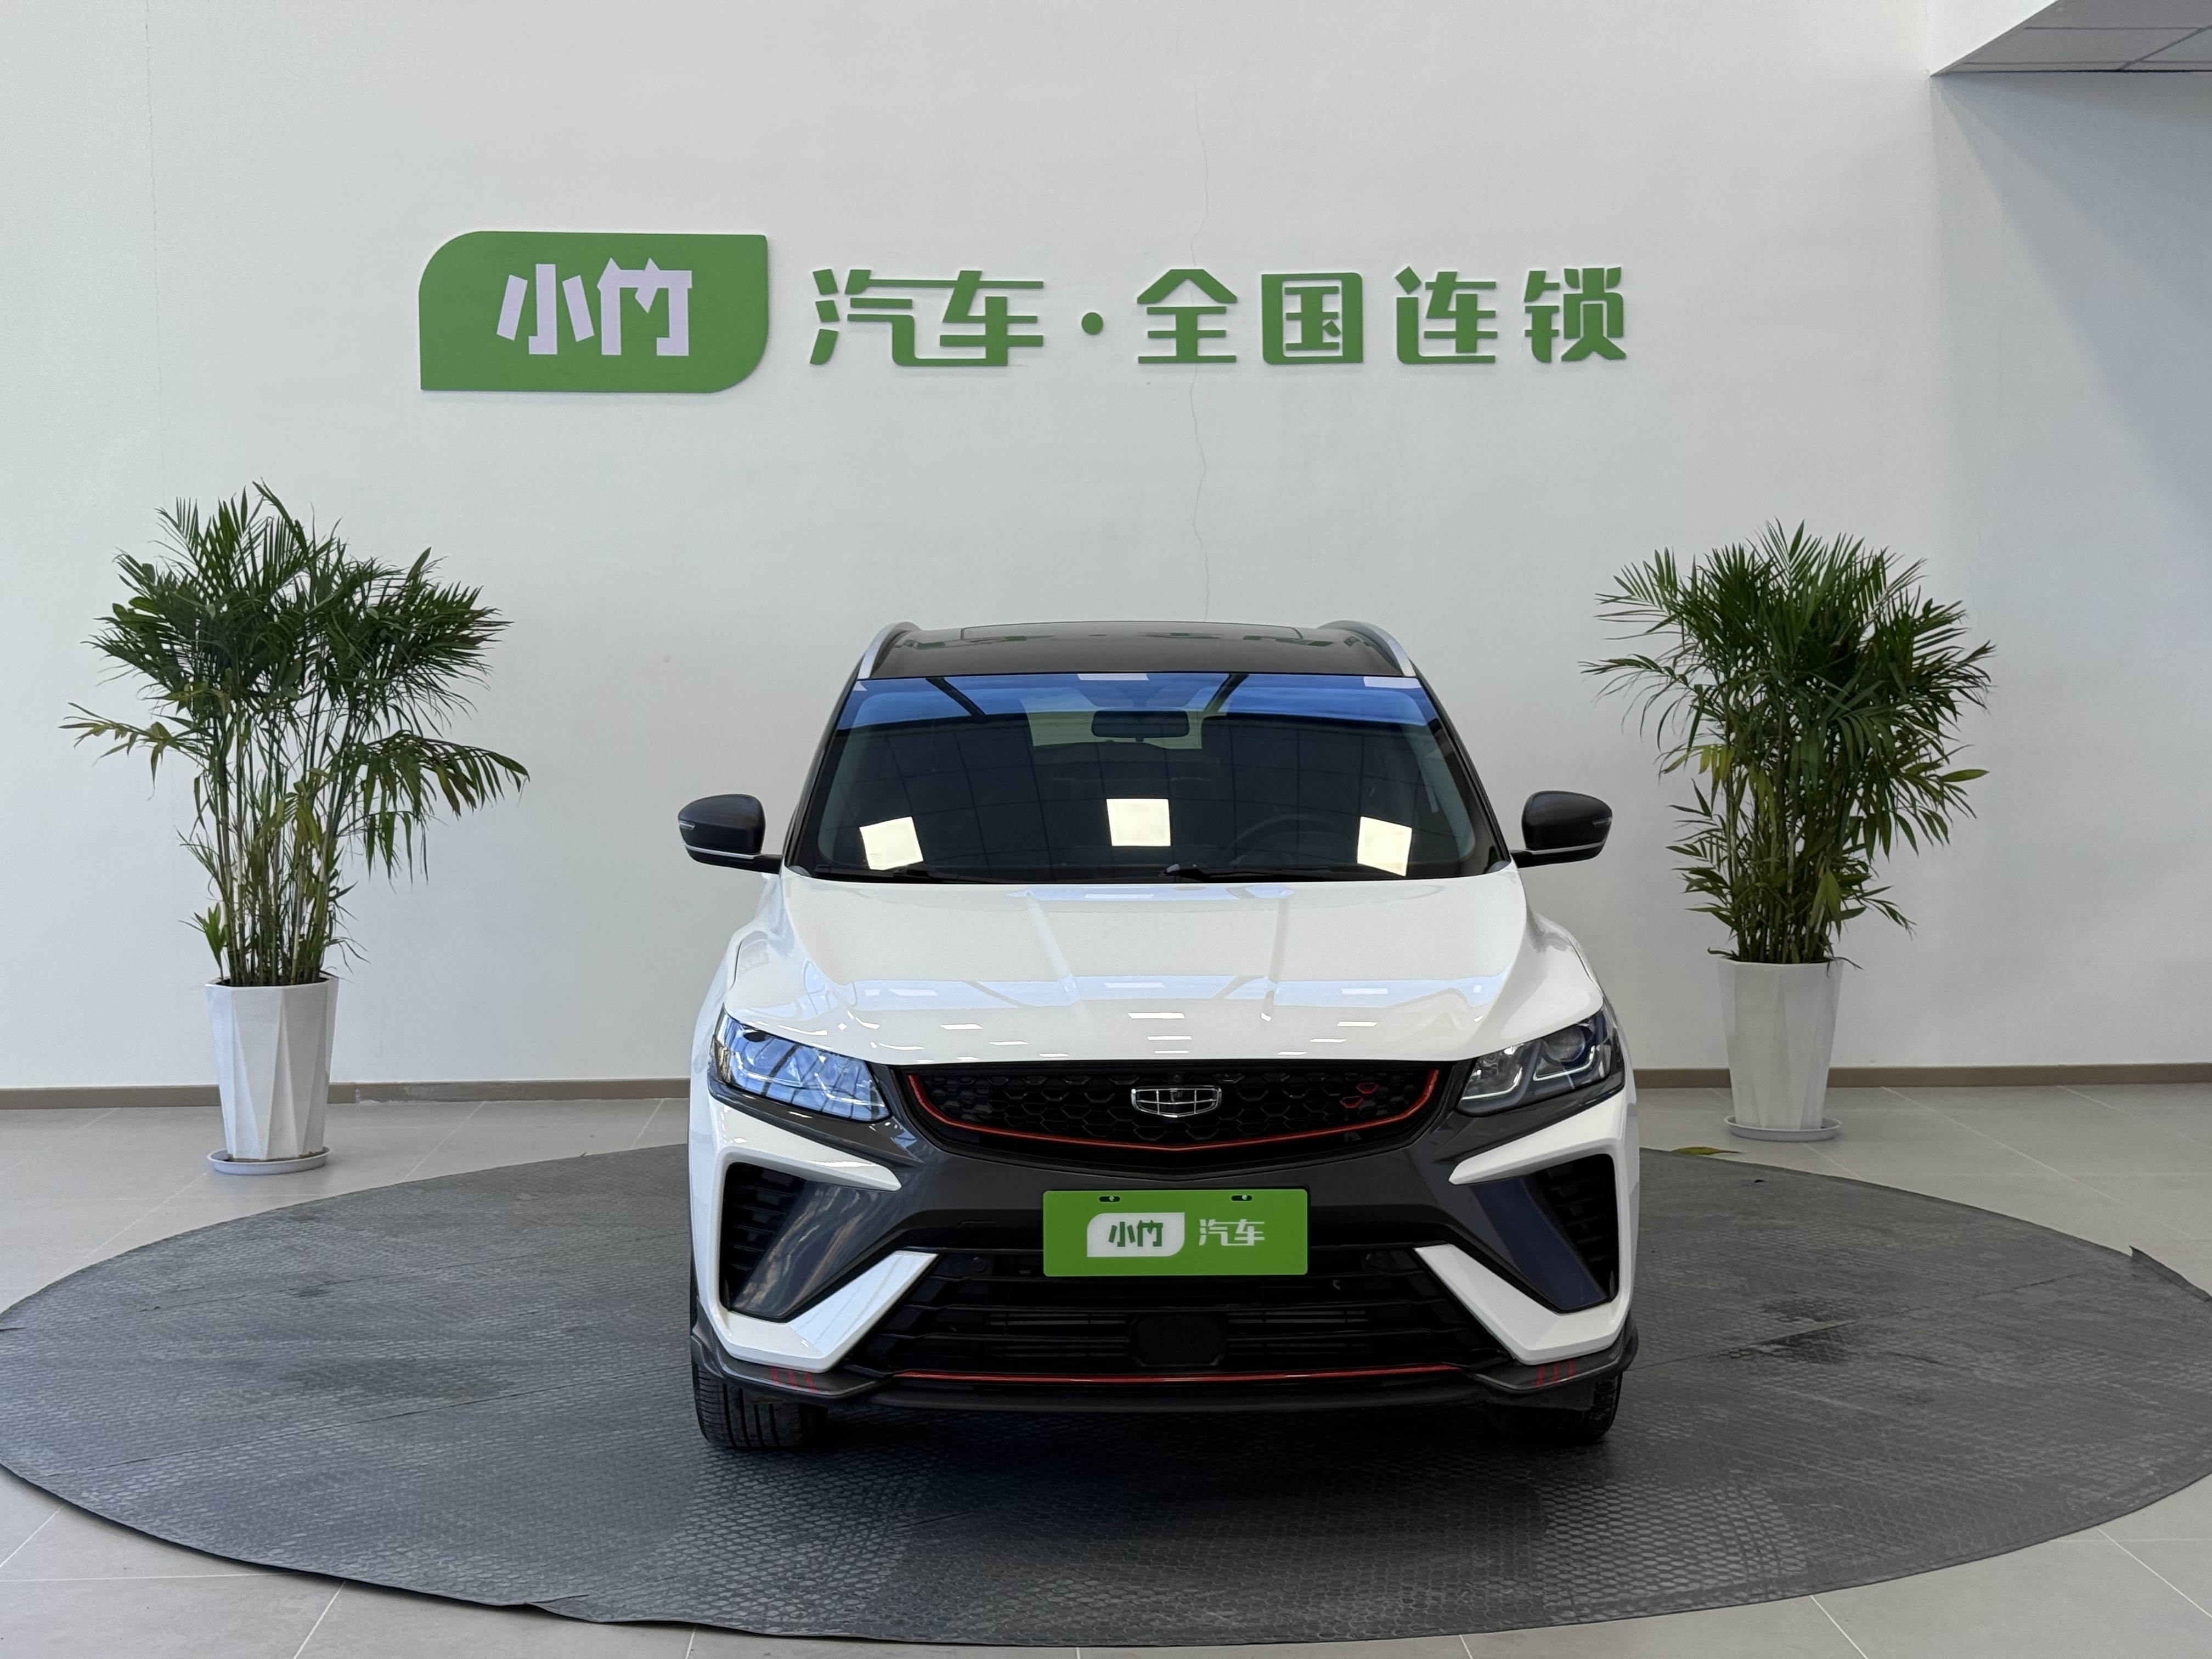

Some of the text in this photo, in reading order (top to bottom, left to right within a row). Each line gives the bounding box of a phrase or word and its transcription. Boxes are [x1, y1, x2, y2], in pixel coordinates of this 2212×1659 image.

[496, 257, 693, 357] 小竹
[1108, 1219, 1265, 1248] 小竹 汽车
